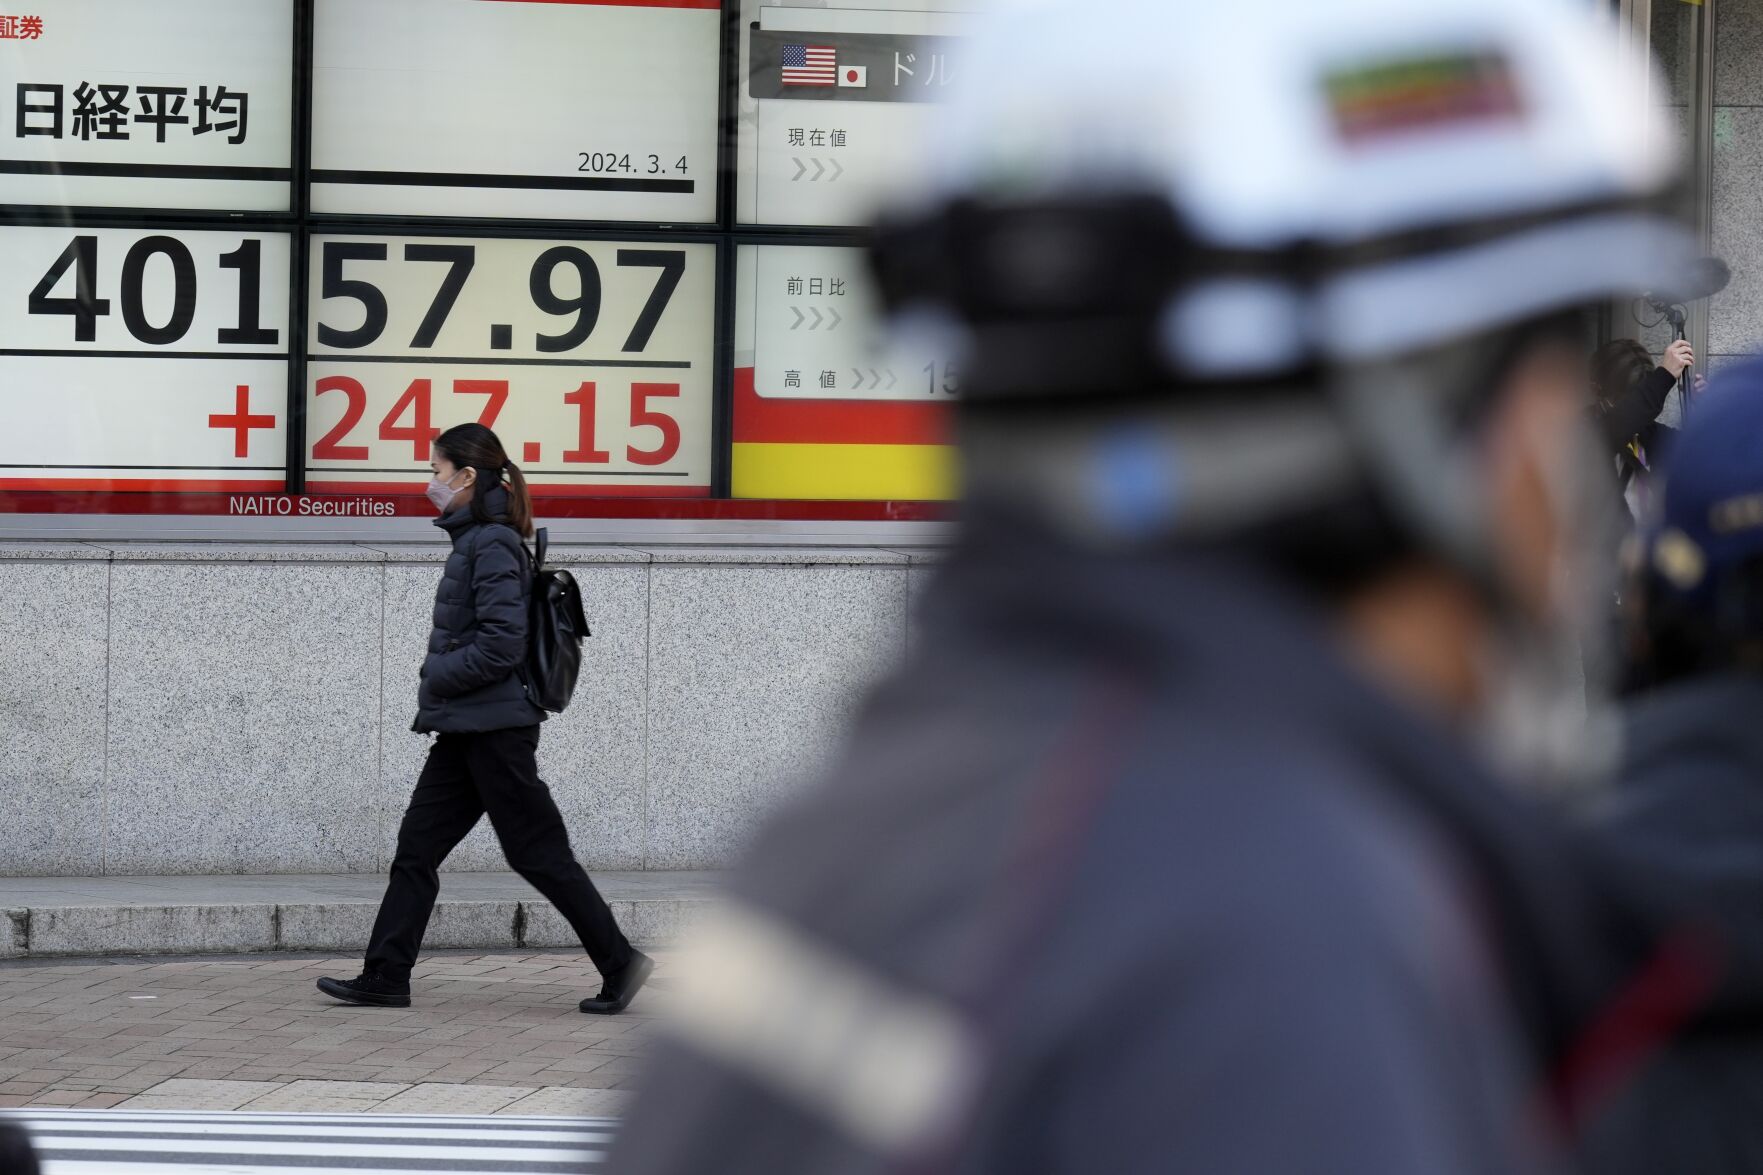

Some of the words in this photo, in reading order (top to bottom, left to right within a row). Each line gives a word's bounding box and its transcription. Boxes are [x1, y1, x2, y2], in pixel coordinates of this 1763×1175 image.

[16, 80, 249, 145] 日経平均
[788, 128, 847, 147] 現在値
[787, 276, 845, 296] 前日比
[229, 496, 292, 515] NAITO
[298, 497, 395, 516] Securities
